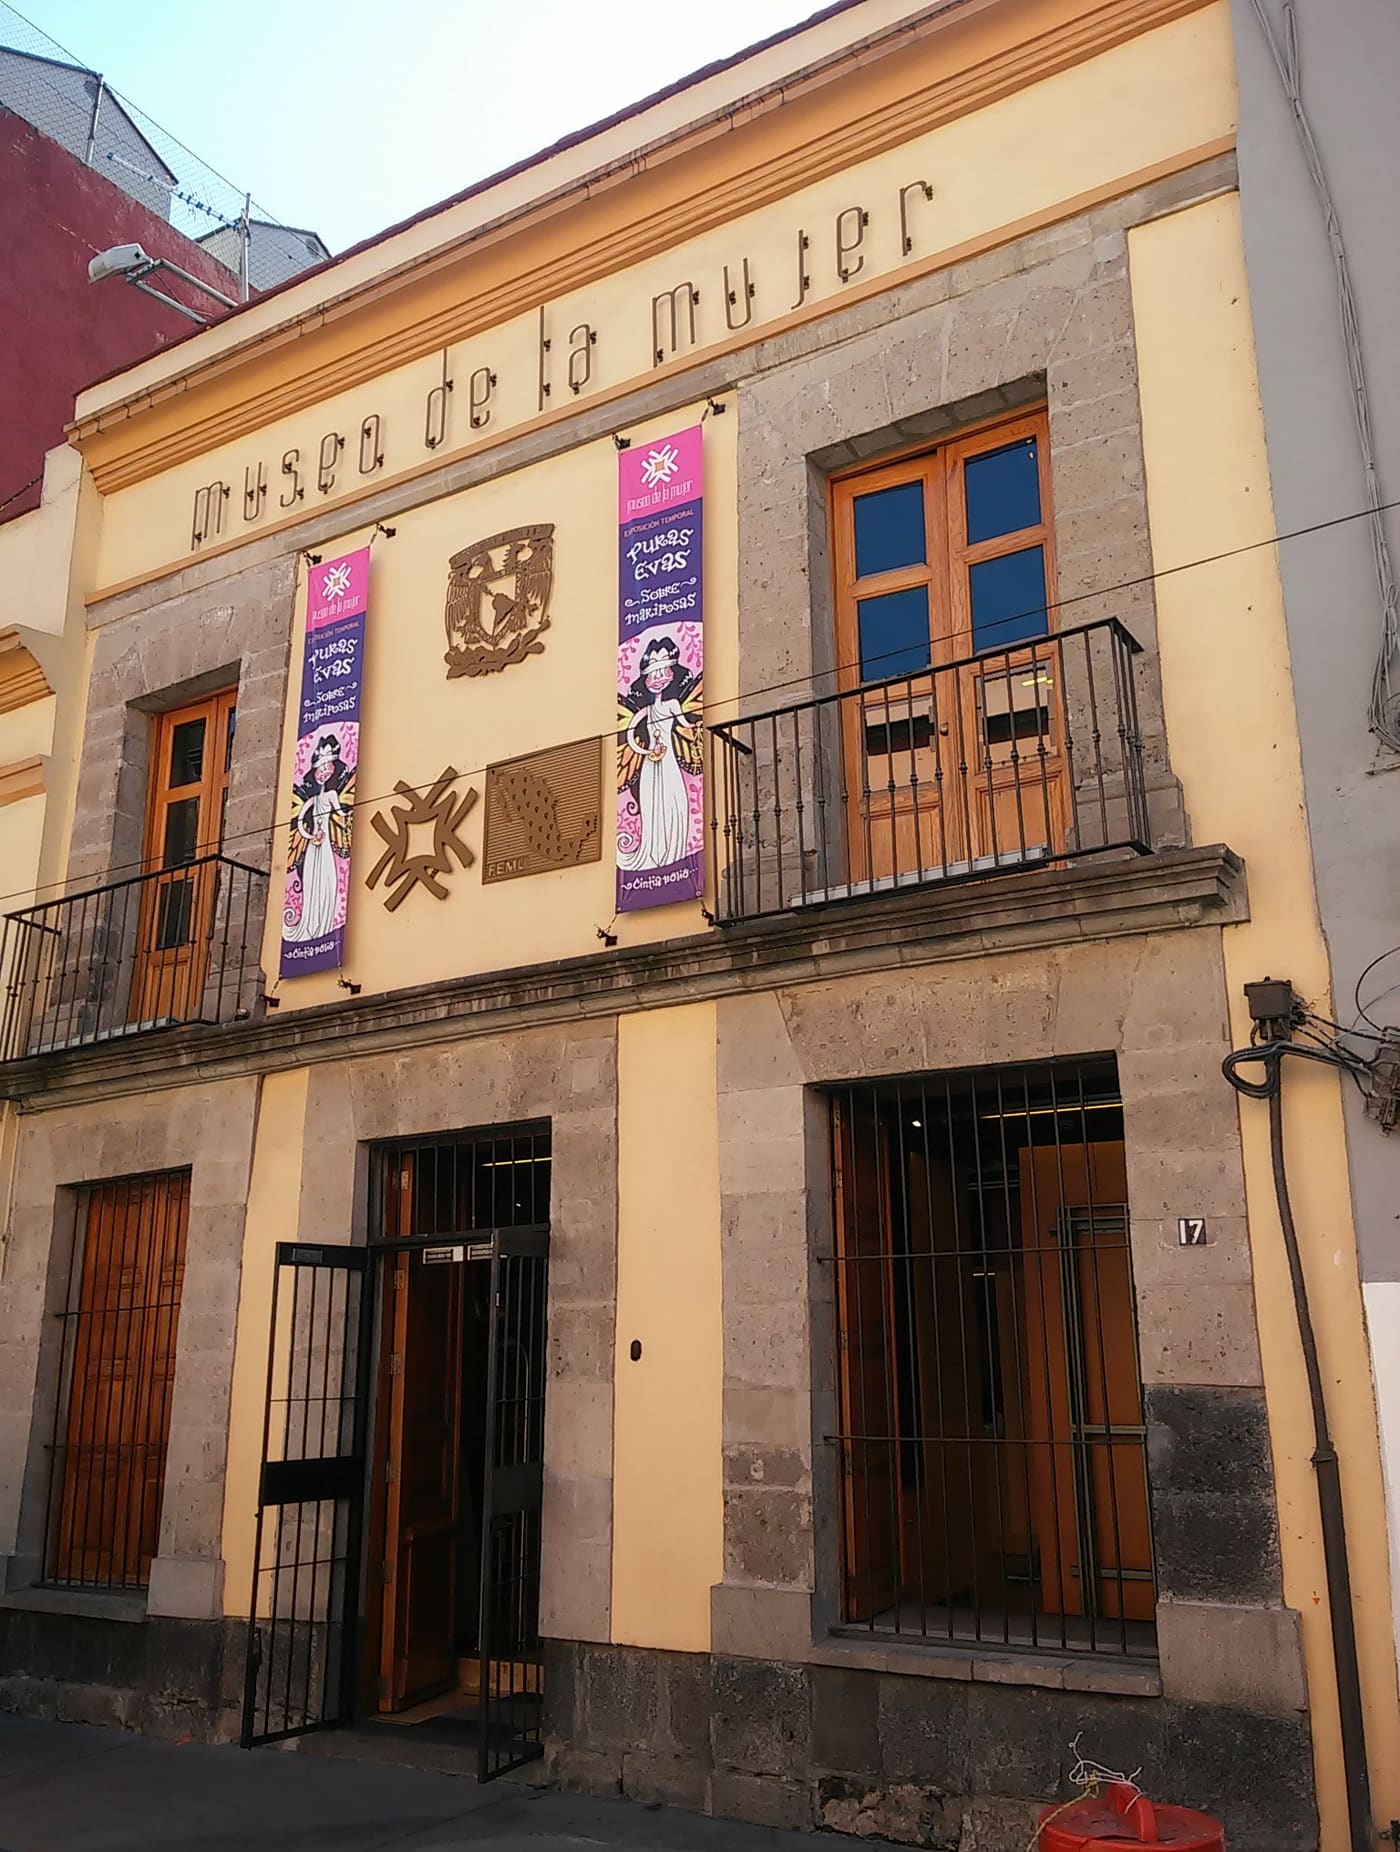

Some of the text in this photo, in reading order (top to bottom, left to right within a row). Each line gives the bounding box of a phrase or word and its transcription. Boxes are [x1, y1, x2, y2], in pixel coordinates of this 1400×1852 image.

[191, 180, 932, 551] museo de la mujer
[626, 495, 651, 515] museo
[651, 486, 661, 504] de
[670, 480, 694, 500] mujer
[661, 509, 694, 525] TEMPORAL
[488, 855, 527, 877] FEMU
[1179, 1219, 1204, 1245] 17
